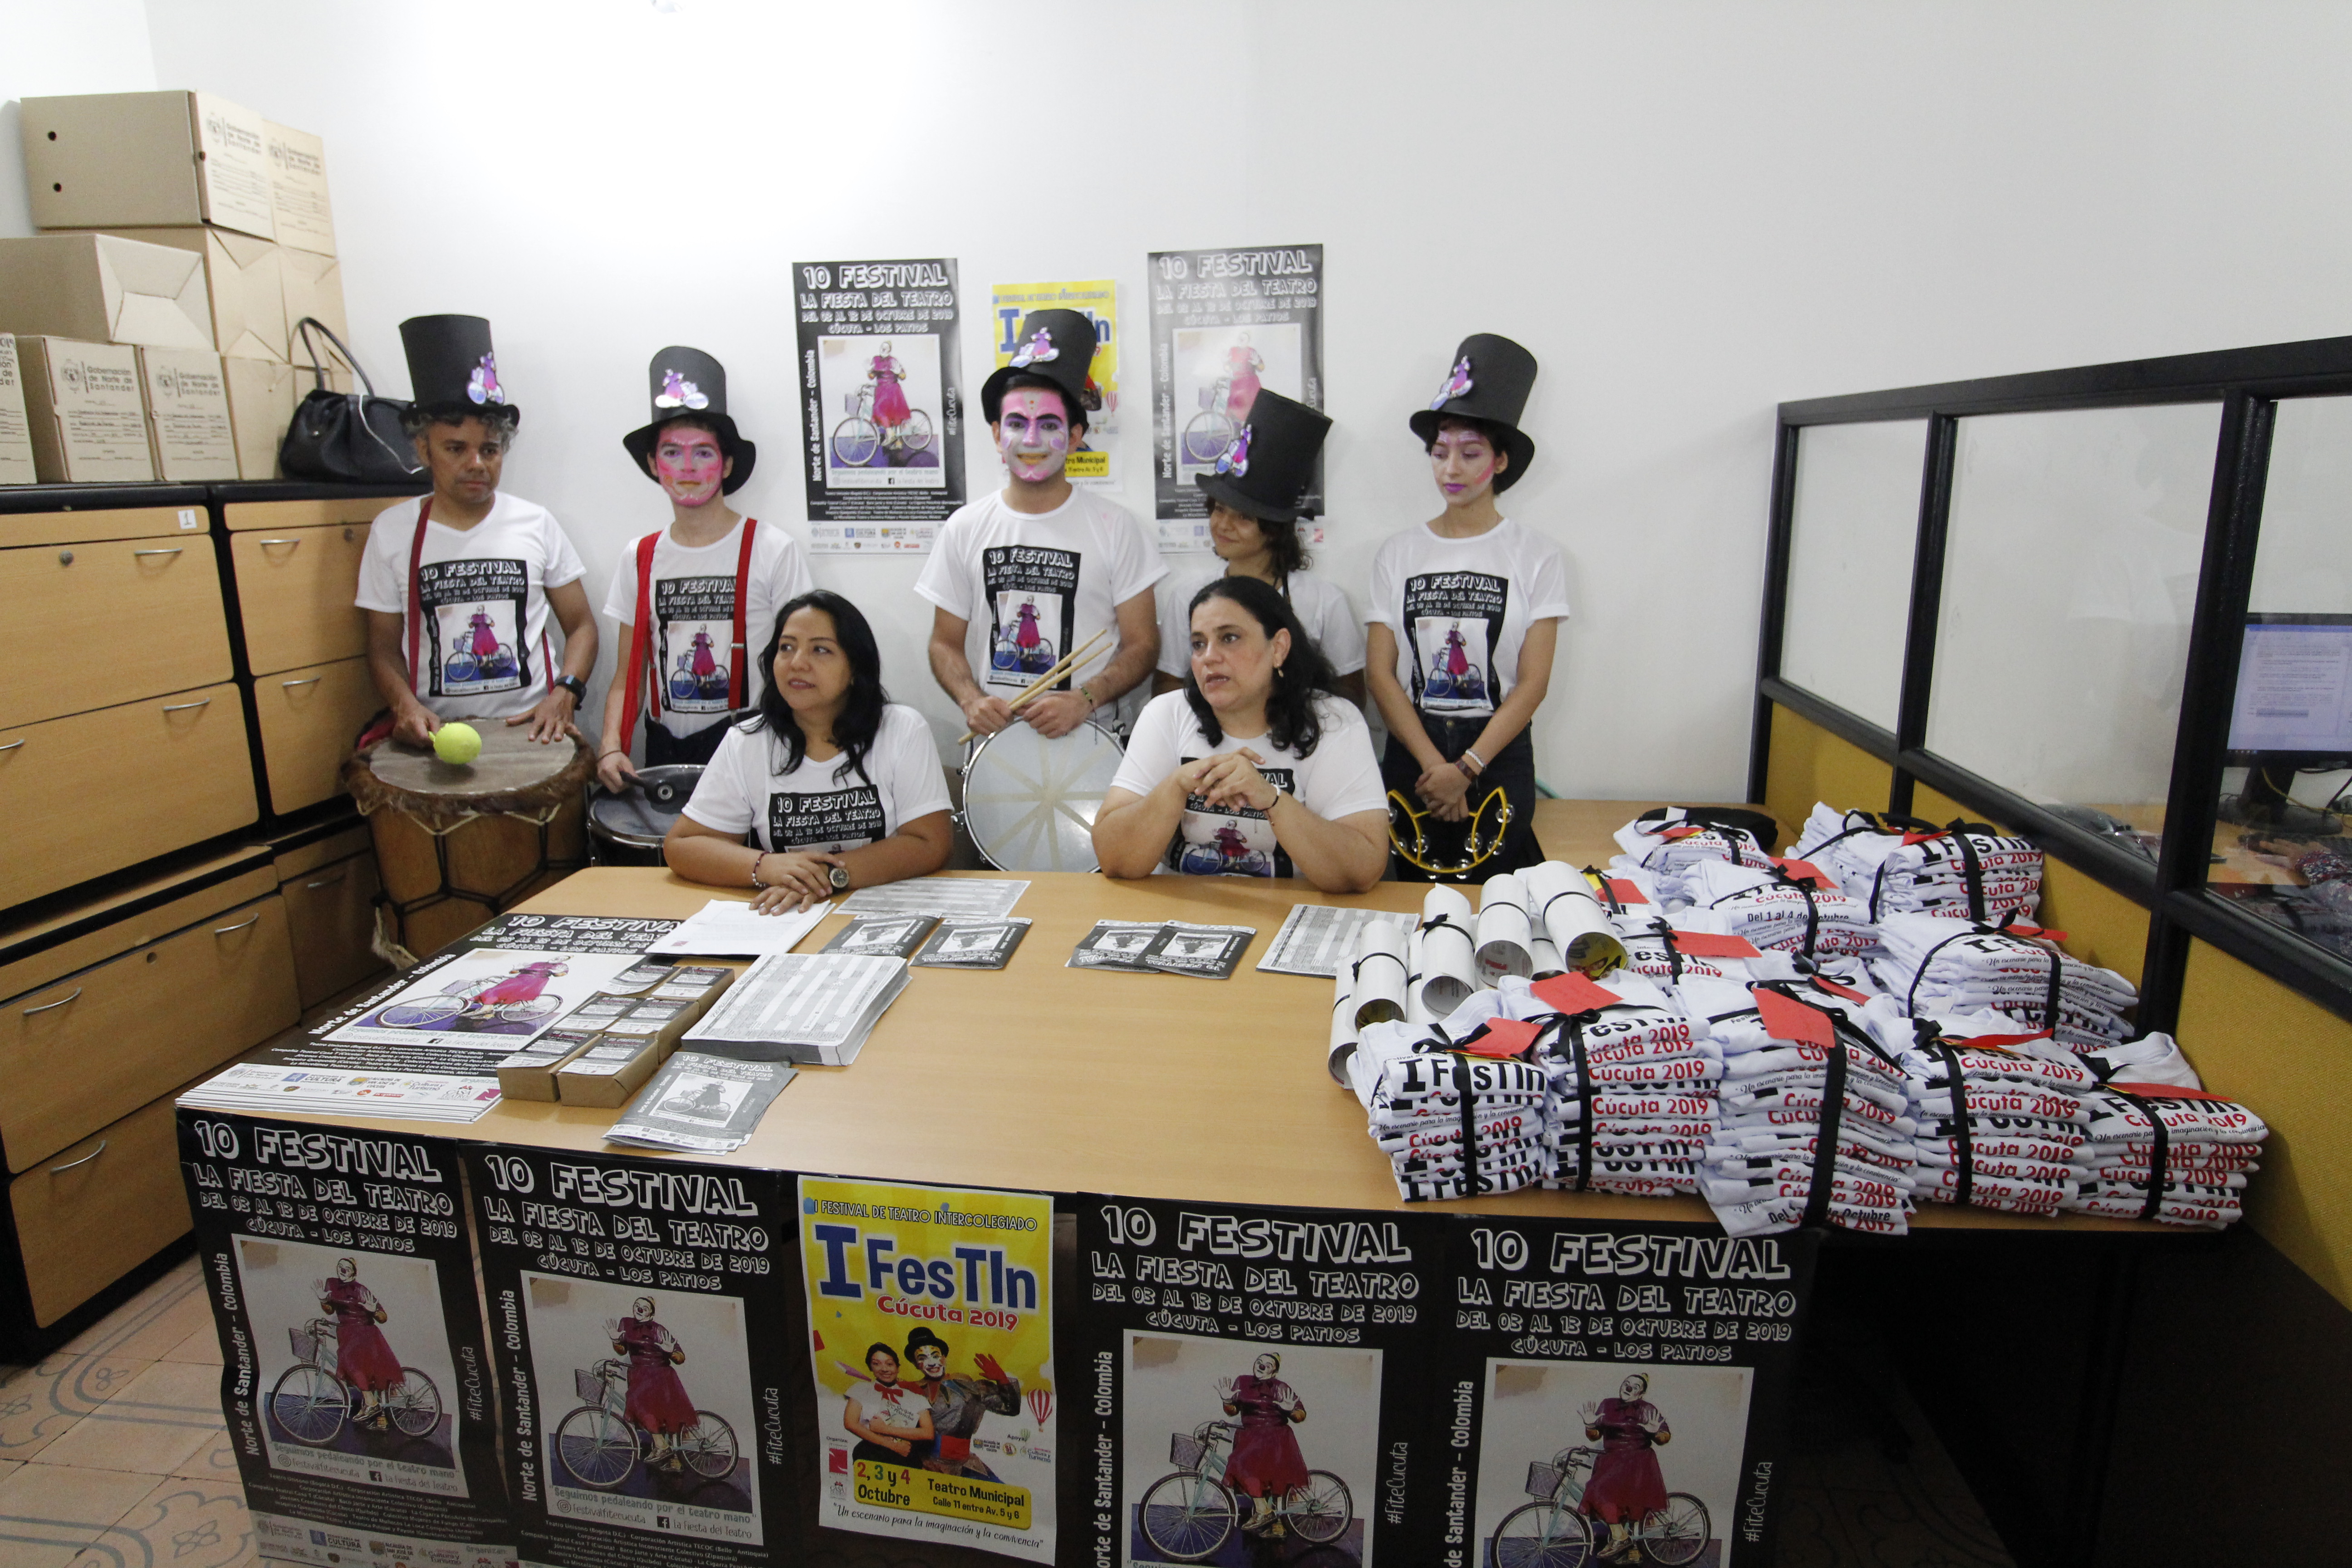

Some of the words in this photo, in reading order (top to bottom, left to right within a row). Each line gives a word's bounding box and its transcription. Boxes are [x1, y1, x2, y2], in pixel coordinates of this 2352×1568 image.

[803, 266, 831, 289] 10
[839, 263, 949, 289] FESTIVAL
[1159, 256, 1187, 280] 10
[1197, 250, 1313, 278] FESTIVAL
[800, 293, 818, 309] LA
[821, 292, 868, 309] FIESTA
[872, 292, 897, 308] DEL
[901, 290, 954, 308] TEATRO
[1155, 285, 1173, 300] LA
[1177, 283, 1225, 299] FIESTA
[1231, 280, 1258, 297] DEL
[1262, 278, 1317, 295] TEATRO
[805, 350, 817, 388] Colombia
[808, 399, 820, 442] Santander
[810, 444, 821, 454] de
[813, 456, 822, 482] Norte
[1162, 452, 1172, 479] Norte
[421, 568, 438, 581] 10
[444, 562, 521, 577] FESTIVAL
[989, 551, 1005, 565] 10
[1010, 548, 1073, 568] FESTIVAL
[662, 582, 675, 595] 10
[1410, 578, 1426, 591] 10
[1431, 574, 1500, 592] FESTIVAL
[778, 797, 793, 813] 10
[799, 790, 876, 813] FESTIVAL
[773, 816, 783, 827] LA
[785, 815, 820, 827] FIESTA
[823, 813, 842, 824] DEL
[845, 808, 881, 821] TEATRO
[1814, 895, 1847, 903] 2019
[482, 927, 506, 936] LA
[509, 928, 574, 939] FIESTA
[578, 930, 613, 940] DEL
[508, 915, 546, 928] 10
[1649, 1024, 1689, 1041] 2019
[704, 1058, 773, 1072] FESTIVAL
[1431, 1059, 1544, 1092] FsTIn
[1589, 1065, 1654, 1082] Cúcuta
[1662, 1060, 1704, 1079] 2019
[1961, 1056, 2033, 1072] Cúcuta
[2039, 1063, 2084, 1082] 2019
[1592, 1098, 1659, 1115] Cúcuta
[1667, 1098, 1708, 1114] 2019
[194, 1121, 239, 1159] 10
[254, 1127, 442, 1181] FESTIVAL
[193, 1163, 223, 1188] LA
[229, 1168, 307, 1199] FIESTA
[314, 1178, 357, 1204] DEL
[364, 1183, 453, 1215] TEATRO
[485, 1155, 534, 1193] 10
[550, 1162, 758, 1215] FESTIVAL
[484, 1197, 515, 1222] LA
[522, 1202, 605, 1236] FIESTA
[613, 1215, 660, 1241] DEL
[669, 1220, 769, 1251] TEATRO
[815, 1200, 818, 1212] I
[821, 1200, 869, 1218] FESTIVAL
[872, 1205, 885, 1219] DE
[888, 1206, 930, 1223] TEATRO
[934, 1210, 1037, 1231] INTERCOLEGIADO
[247, 1216, 304, 1238] CÚCUTA
[323, 1228, 353, 1244] LOS
[359, 1233, 415, 1252] PATIOS
[1101, 1205, 1156, 1246] 10
[1178, 1211, 1411, 1264] FESTIVAL
[490, 1226, 518, 1245] DEL
[523, 1230, 543, 1248] 03
[549, 1235, 567, 1252] AL
[572, 1238, 588, 1256] 13
[595, 1241, 616, 1259] DE
[622, 1245, 695, 1268] OCTUBRE
[701, 1253, 722, 1270] DE
[730, 1255, 769, 1274] 2019
[1470, 1228, 1529, 1271] 10
[1550, 1232, 1791, 1280] FESTIVAL
[538, 1252, 599, 1276] CÚCUTA
[620, 1267, 652, 1283] LOS
[660, 1271, 721, 1290] PATIOS
[815, 1224, 862, 1298] I
[867, 1238, 1036, 1309] FesTIn
[1092, 1251, 1126, 1279] LA
[1136, 1255, 1234, 1290] FIESTA
[1245, 1266, 1297, 1295] DEL
[1309, 1270, 1420, 1300] TEATRO
[216, 1253, 234, 1311] Colombia
[1457, 1277, 1493, 1306] LA
[1504, 1280, 1606, 1311] FIESTA
[1617, 1285, 1671, 1313] DEL
[1684, 1287, 1796, 1317] TEATRO
[877, 1294, 963, 1324] Cúcuta
[969, 1308, 1019, 1333] 2019
[233, 1327, 251, 1396] Santander
[1511, 1335, 1588, 1357] CÚCUTA
[1614, 1342, 1652, 1359] LOS
[1661, 1344, 1732, 1362] PATIOS
[461, 1346, 482, 1421] #FiteCucuta
[238, 1401, 249, 1417] de
[1450, 1381, 1473, 1449] Colombia
[243, 1418, 260, 1456] Norte
[857, 1462, 871, 1481] 2,
[874, 1465, 883, 1480] 3
[888, 1471, 897, 1487] y
[901, 1469, 910, 1485] 4
[1094, 1434, 1112, 1507] Santander
[1384, 1442, 1407, 1525] #FiteCucuta
[858, 1484, 910, 1506] Octubre
[927, 1478, 967, 1497] Teatro
[969, 1485, 1024, 1507] Municipal
[1445, 1467, 1467, 1546] Santander
[602, 1495, 653, 1511] pedaleando
[657, 1503, 673, 1514] por
[689, 1508, 721, 1521] teatro
[933, 1496, 951, 1508] Calle
[962, 1503, 984, 1514] entre
[986, 1505, 998, 1516] Av.
[1000, 1507, 1005, 1517] 5
[1007, 1510, 1012, 1520] y
[1014, 1510, 1019, 1519] 6
[852, 1509, 890, 1524] escenario
[892, 1516, 912, 1527] para
[914, 1516, 923, 1528] la
[926, 1519, 974, 1535] imaginación
[975, 1528, 981, 1539] y
[983, 1527, 991, 1538] la
